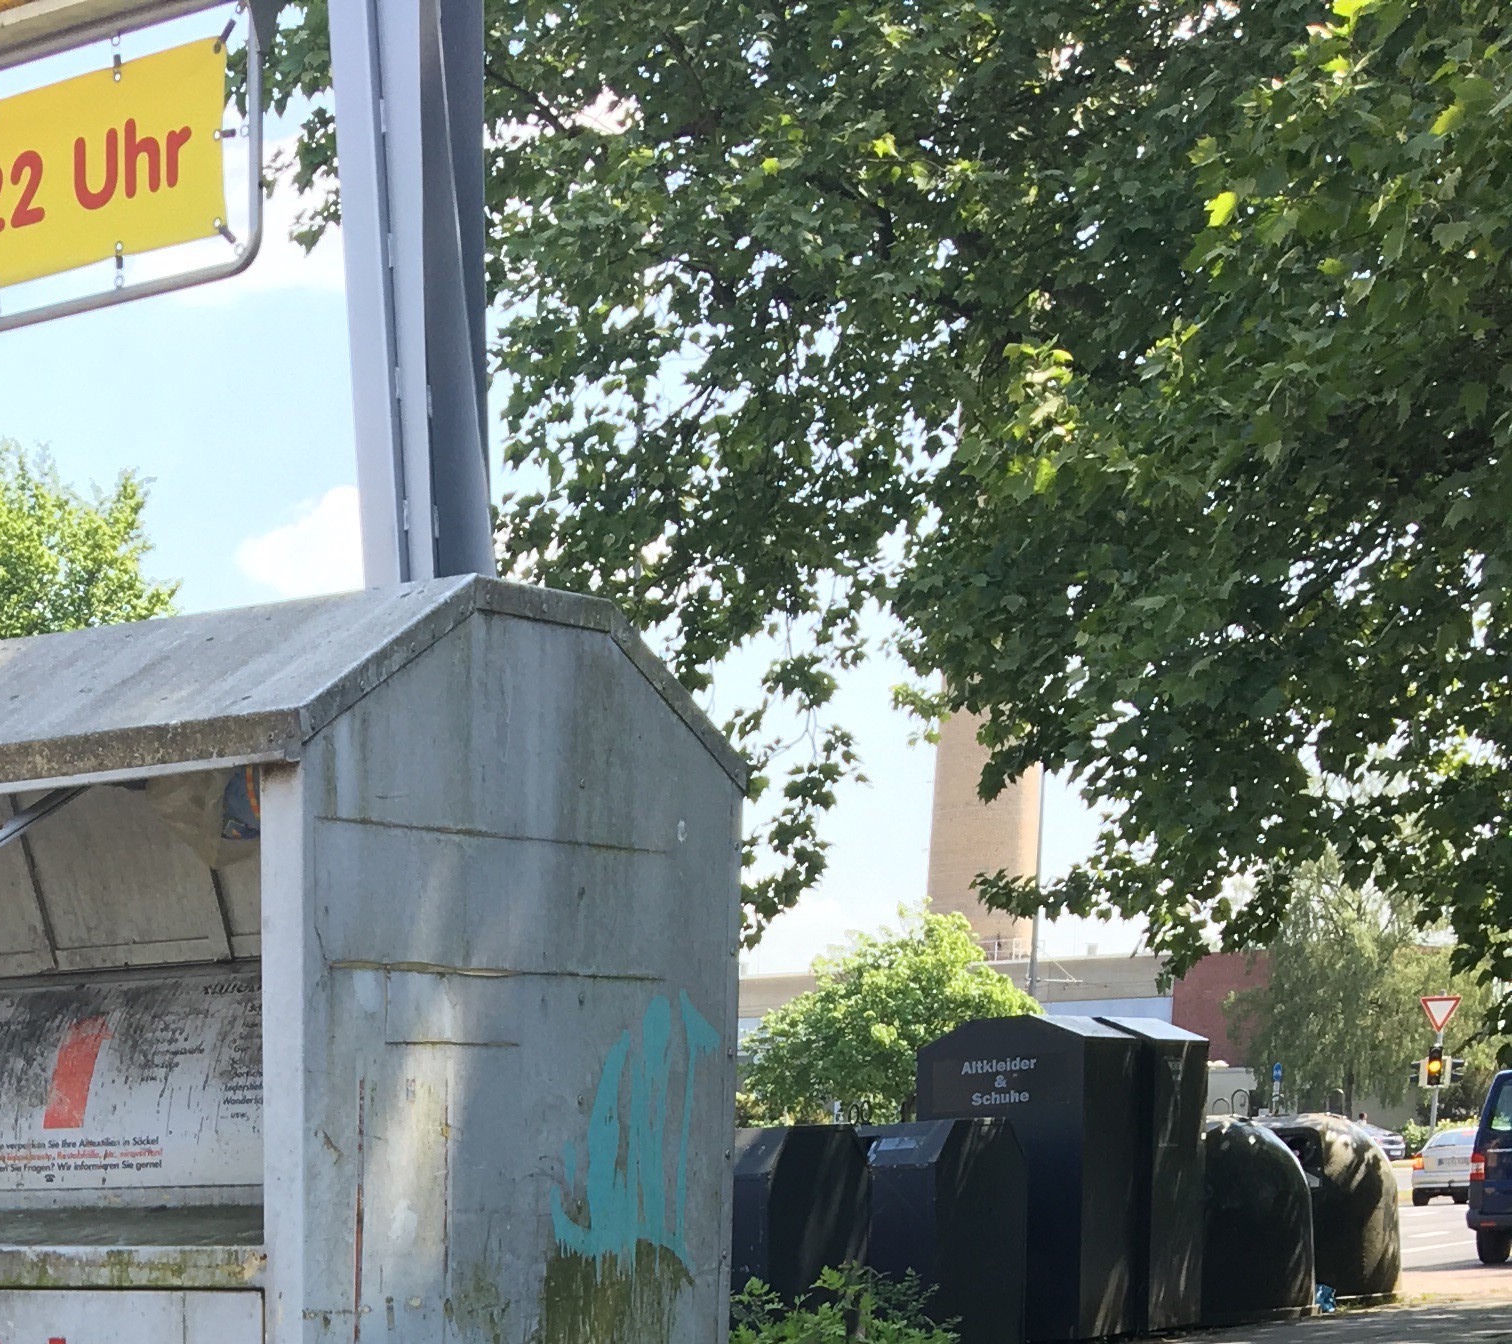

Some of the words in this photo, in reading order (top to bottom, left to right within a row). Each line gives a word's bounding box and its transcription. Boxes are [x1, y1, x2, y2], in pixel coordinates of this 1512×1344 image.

[73, 118, 192, 210] Uhr
[961, 1057, 1036, 1075] Altkleider
[994, 1074, 1007, 1088] &
[971, 1090, 1029, 1106] Schuhe
[122, 1160, 134, 1169] Sie
